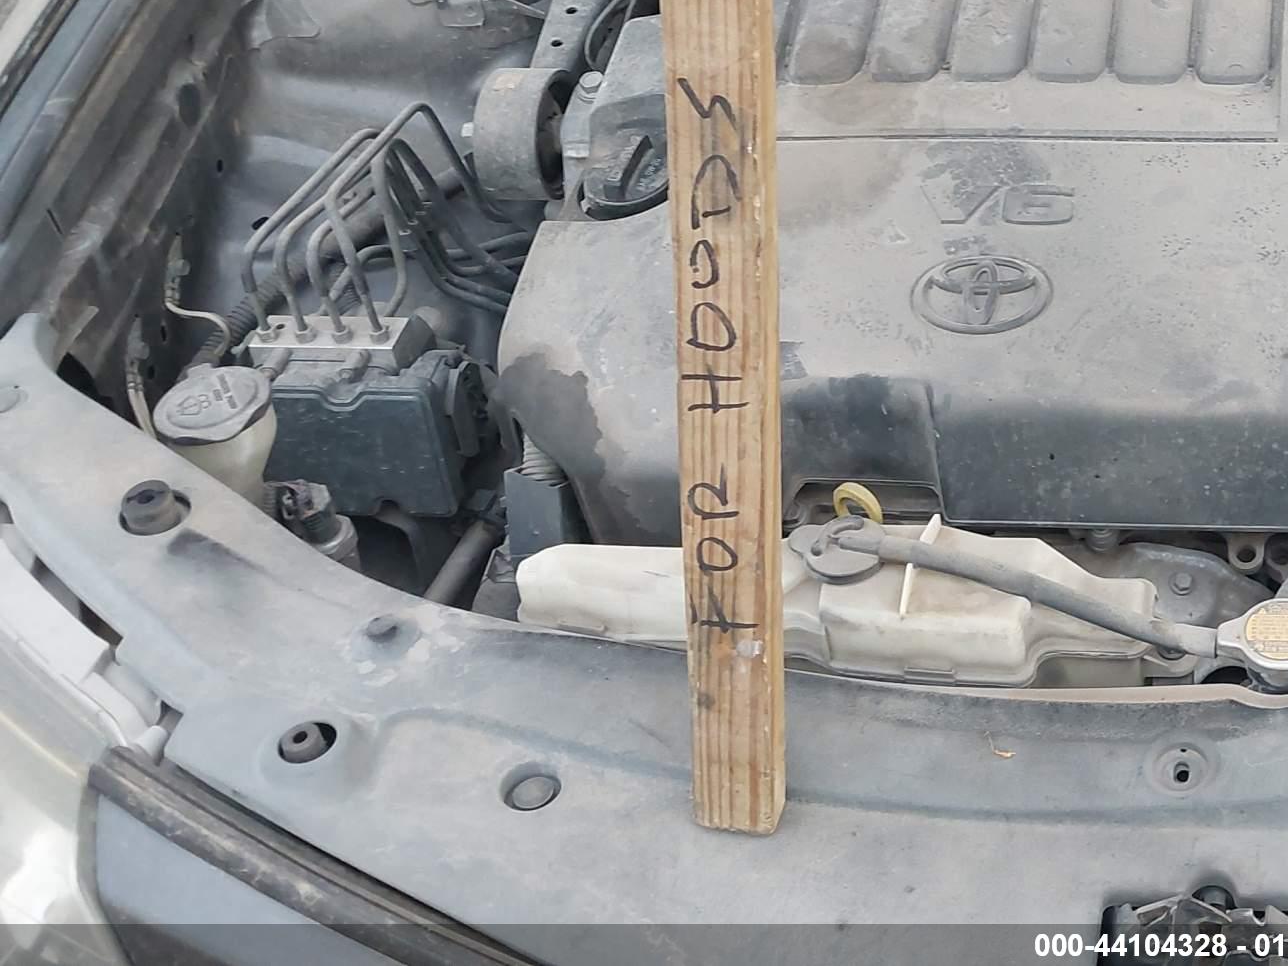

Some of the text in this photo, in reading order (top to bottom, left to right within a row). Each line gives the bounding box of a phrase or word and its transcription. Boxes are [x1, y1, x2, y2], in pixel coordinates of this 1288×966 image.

[919, 183, 1075, 225] V6
[677, 77, 760, 634] FOR HOODS
